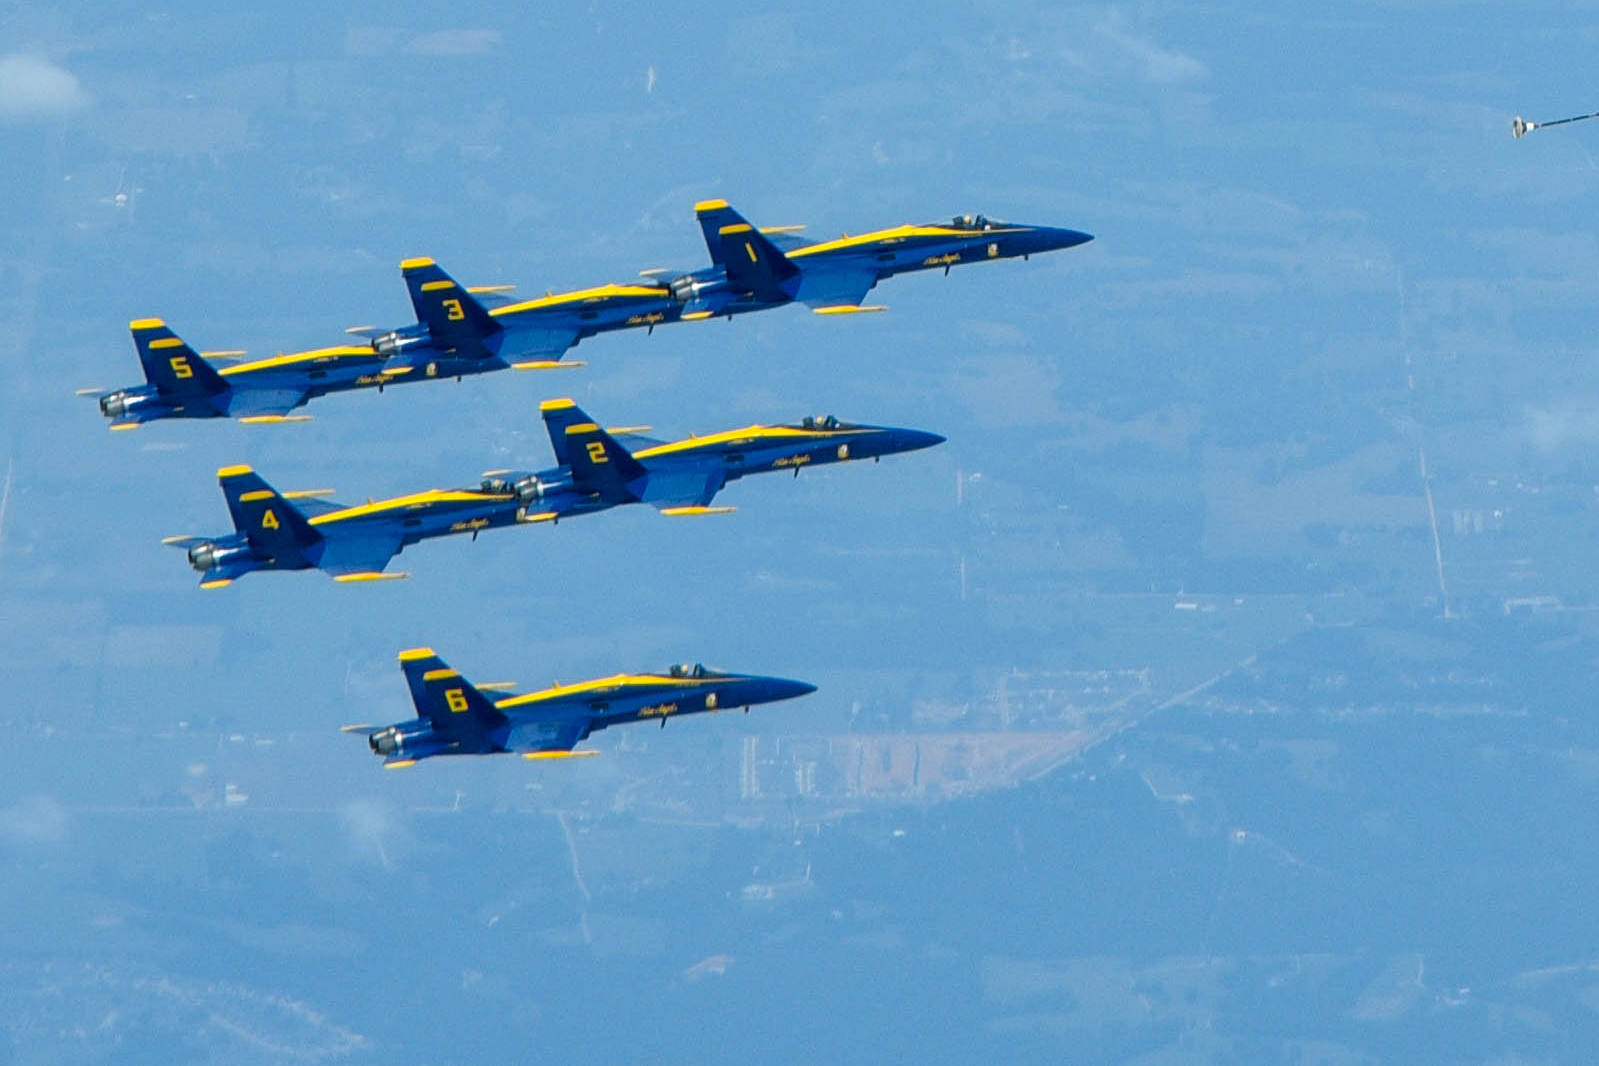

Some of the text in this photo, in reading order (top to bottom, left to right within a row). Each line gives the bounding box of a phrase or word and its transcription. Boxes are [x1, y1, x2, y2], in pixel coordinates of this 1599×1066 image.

[745, 243, 757, 262] 1
[442, 299, 465, 320] 3
[170, 356, 193, 378] 5
[586, 441, 609, 463] 2
[262, 509, 280, 530] 4
[445, 688, 469, 712] 6
